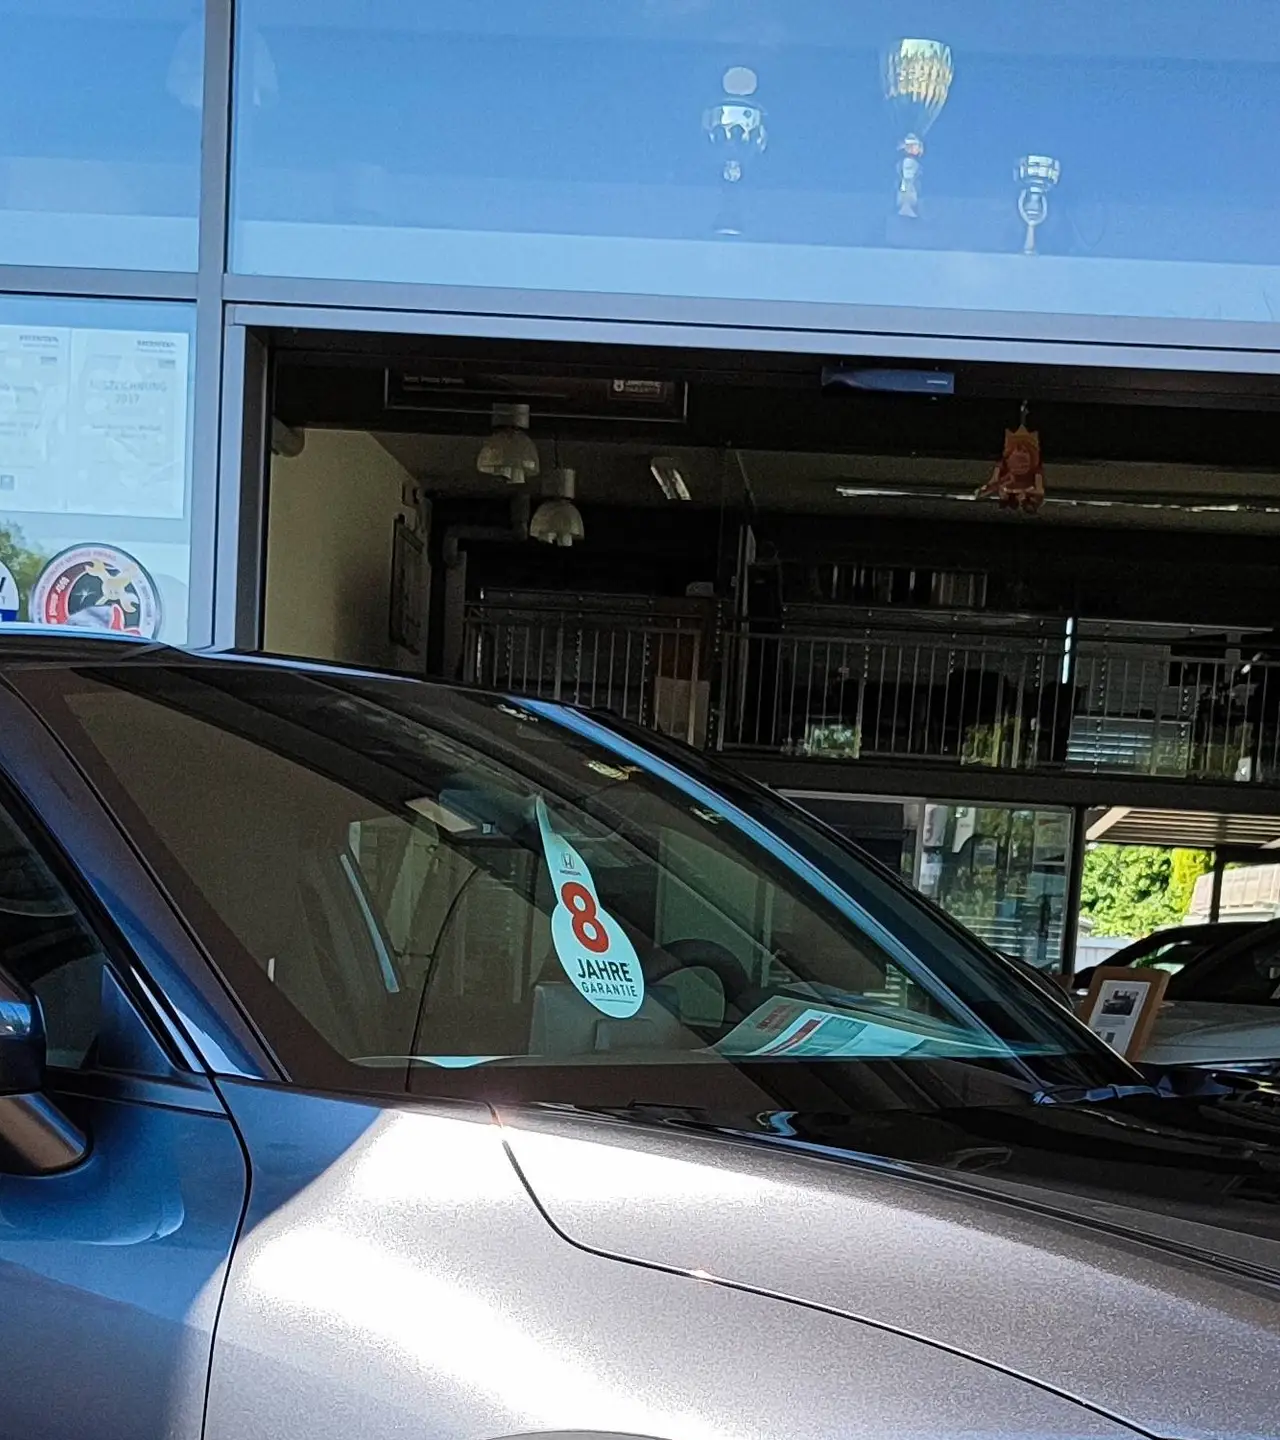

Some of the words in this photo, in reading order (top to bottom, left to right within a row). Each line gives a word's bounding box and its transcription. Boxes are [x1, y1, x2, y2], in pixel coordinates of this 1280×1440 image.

[561, 882, 609, 953] 8
[577, 959, 633, 982] JAHRE
[581, 981, 638, 998] GARANTIE
